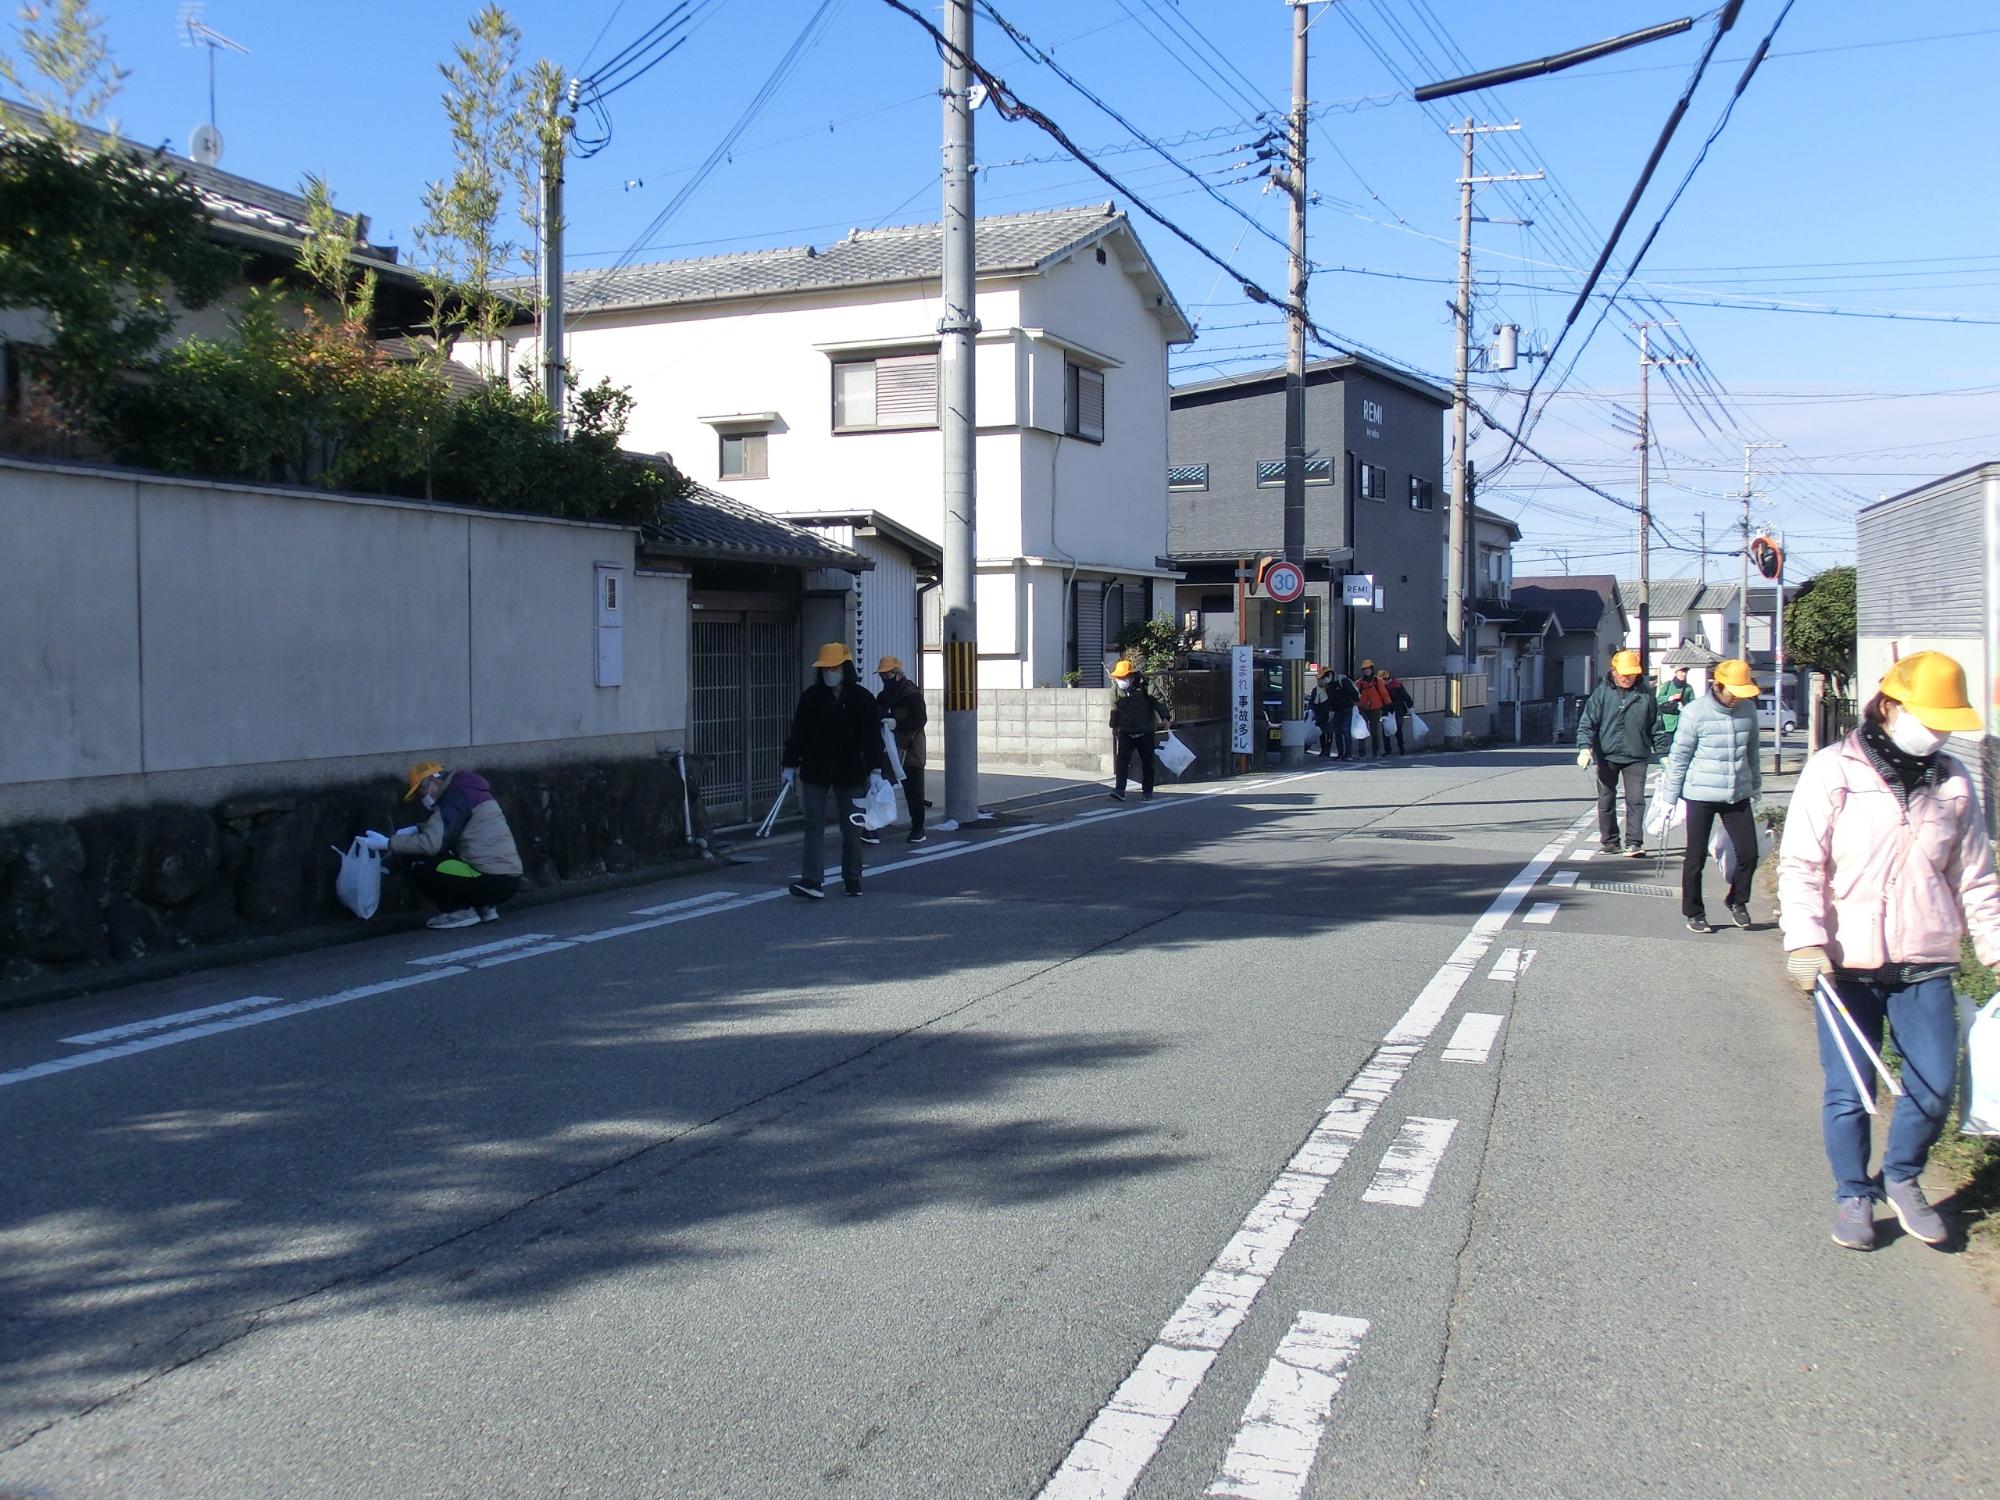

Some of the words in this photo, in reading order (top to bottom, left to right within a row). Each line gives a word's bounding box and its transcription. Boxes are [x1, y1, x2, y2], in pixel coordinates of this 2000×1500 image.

[1363, 400, 1383, 426] REMI
[1275, 574, 1295, 590] 30
[1346, 585, 1368, 593] REMI
[1238, 651, 1248, 690] とまれ
[1238, 695, 1248, 749] 事故多し
